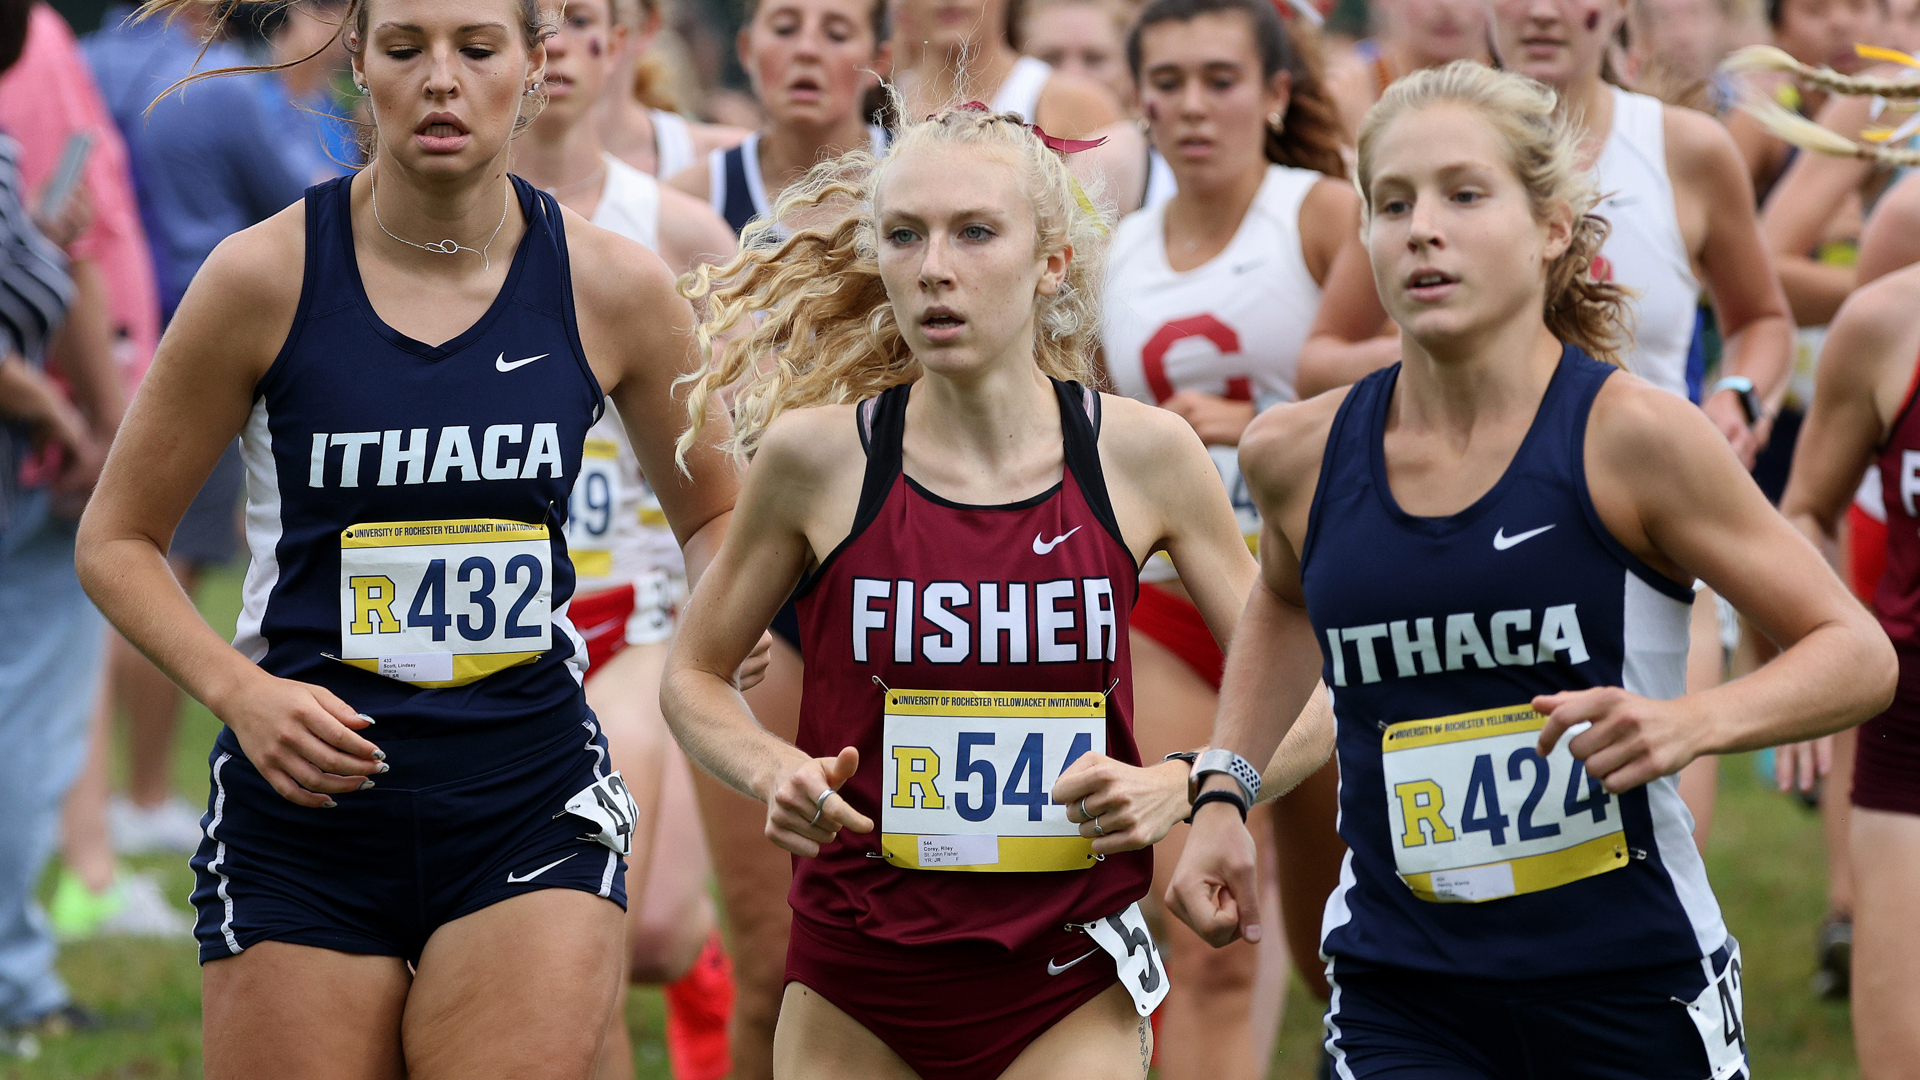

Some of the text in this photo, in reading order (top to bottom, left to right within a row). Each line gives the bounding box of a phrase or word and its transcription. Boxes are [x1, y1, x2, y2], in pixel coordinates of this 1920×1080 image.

[309, 422, 563, 488] ITHACA
[354, 523, 539, 538] UNIVERSITY OF ROCHESTER YELLOWJACKET INVITATION
[568, 472, 610, 535] 9
[349, 553, 544, 642] R 432
[852, 575, 1118, 666] FISHER
[1326, 603, 1591, 687] ITHACA
[898, 695, 1093, 708] UNIVERSITY OF ROCHESTER YELLOWJACKET INVITATIONAL
[1444, 718, 1485, 732] ROCHESTER
[890, 745, 945, 810] R
[1394, 746, 1611, 849] R 424
